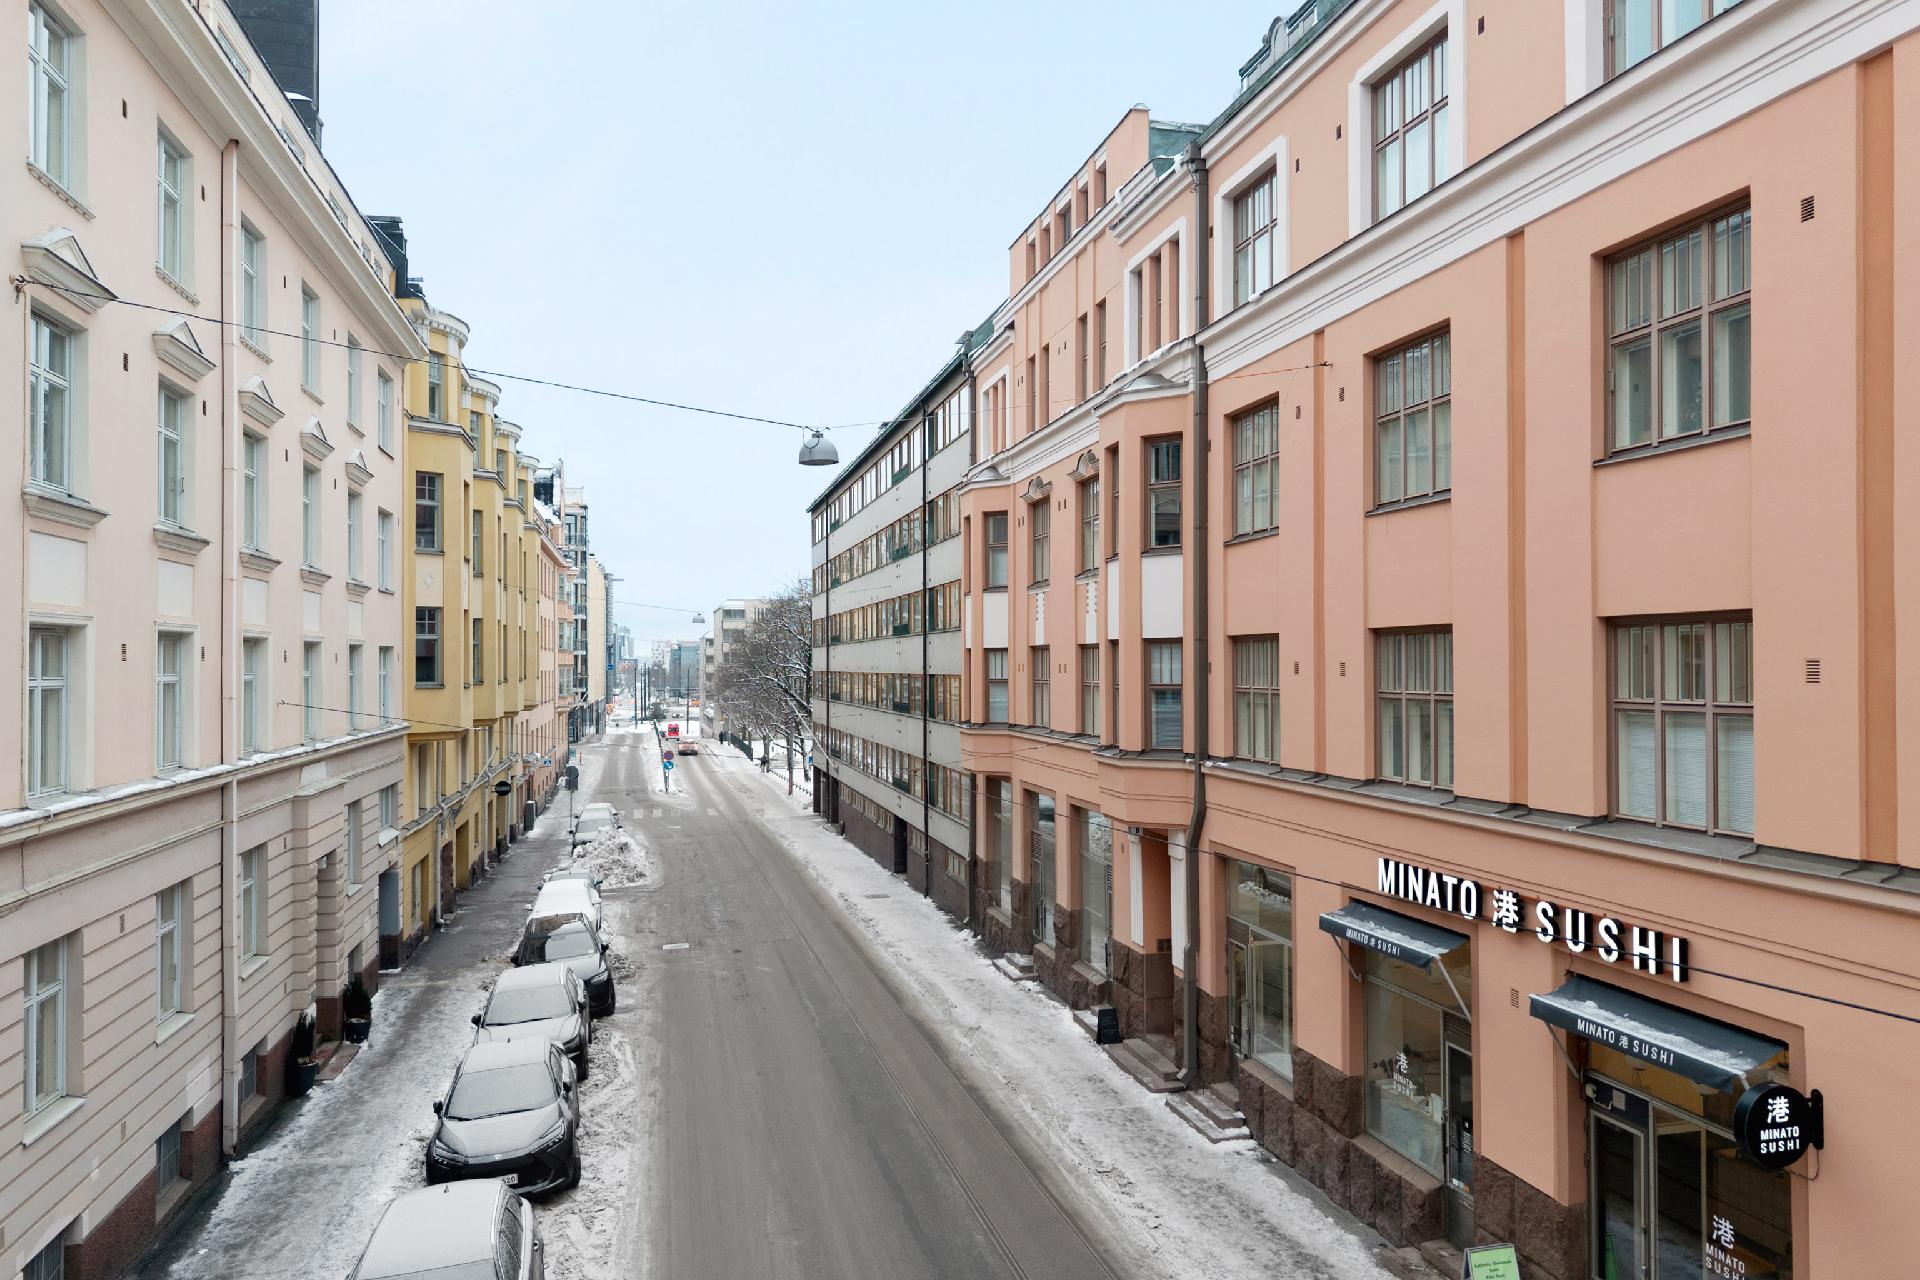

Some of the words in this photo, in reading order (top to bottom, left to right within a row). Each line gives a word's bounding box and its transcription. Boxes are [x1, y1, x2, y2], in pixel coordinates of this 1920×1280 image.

[1378, 857, 1480, 920] MINATO
[1492, 889, 1520, 934] 港
[1535, 901, 1688, 983] SUSHI
[1345, 927, 1368, 944] MINATO
[1377, 939, 1400, 956] SUSHI
[1577, 1018, 1615, 1043] MINATO
[1619, 1035, 1629, 1049] 港
[1633, 1040, 1674, 1066] SUSHI
[1393, 1071, 1413, 1089] MINATO
[1767, 1095, 1790, 1124] 港
[1760, 1125, 1800, 1141] MINATO
[1760, 1138, 1800, 1154] SUSHI
[1712, 1214, 1735, 1249] 港
[1705, 1242, 1745, 1274] MINATO
[1705, 1256, 1745, 1280] SUSH
